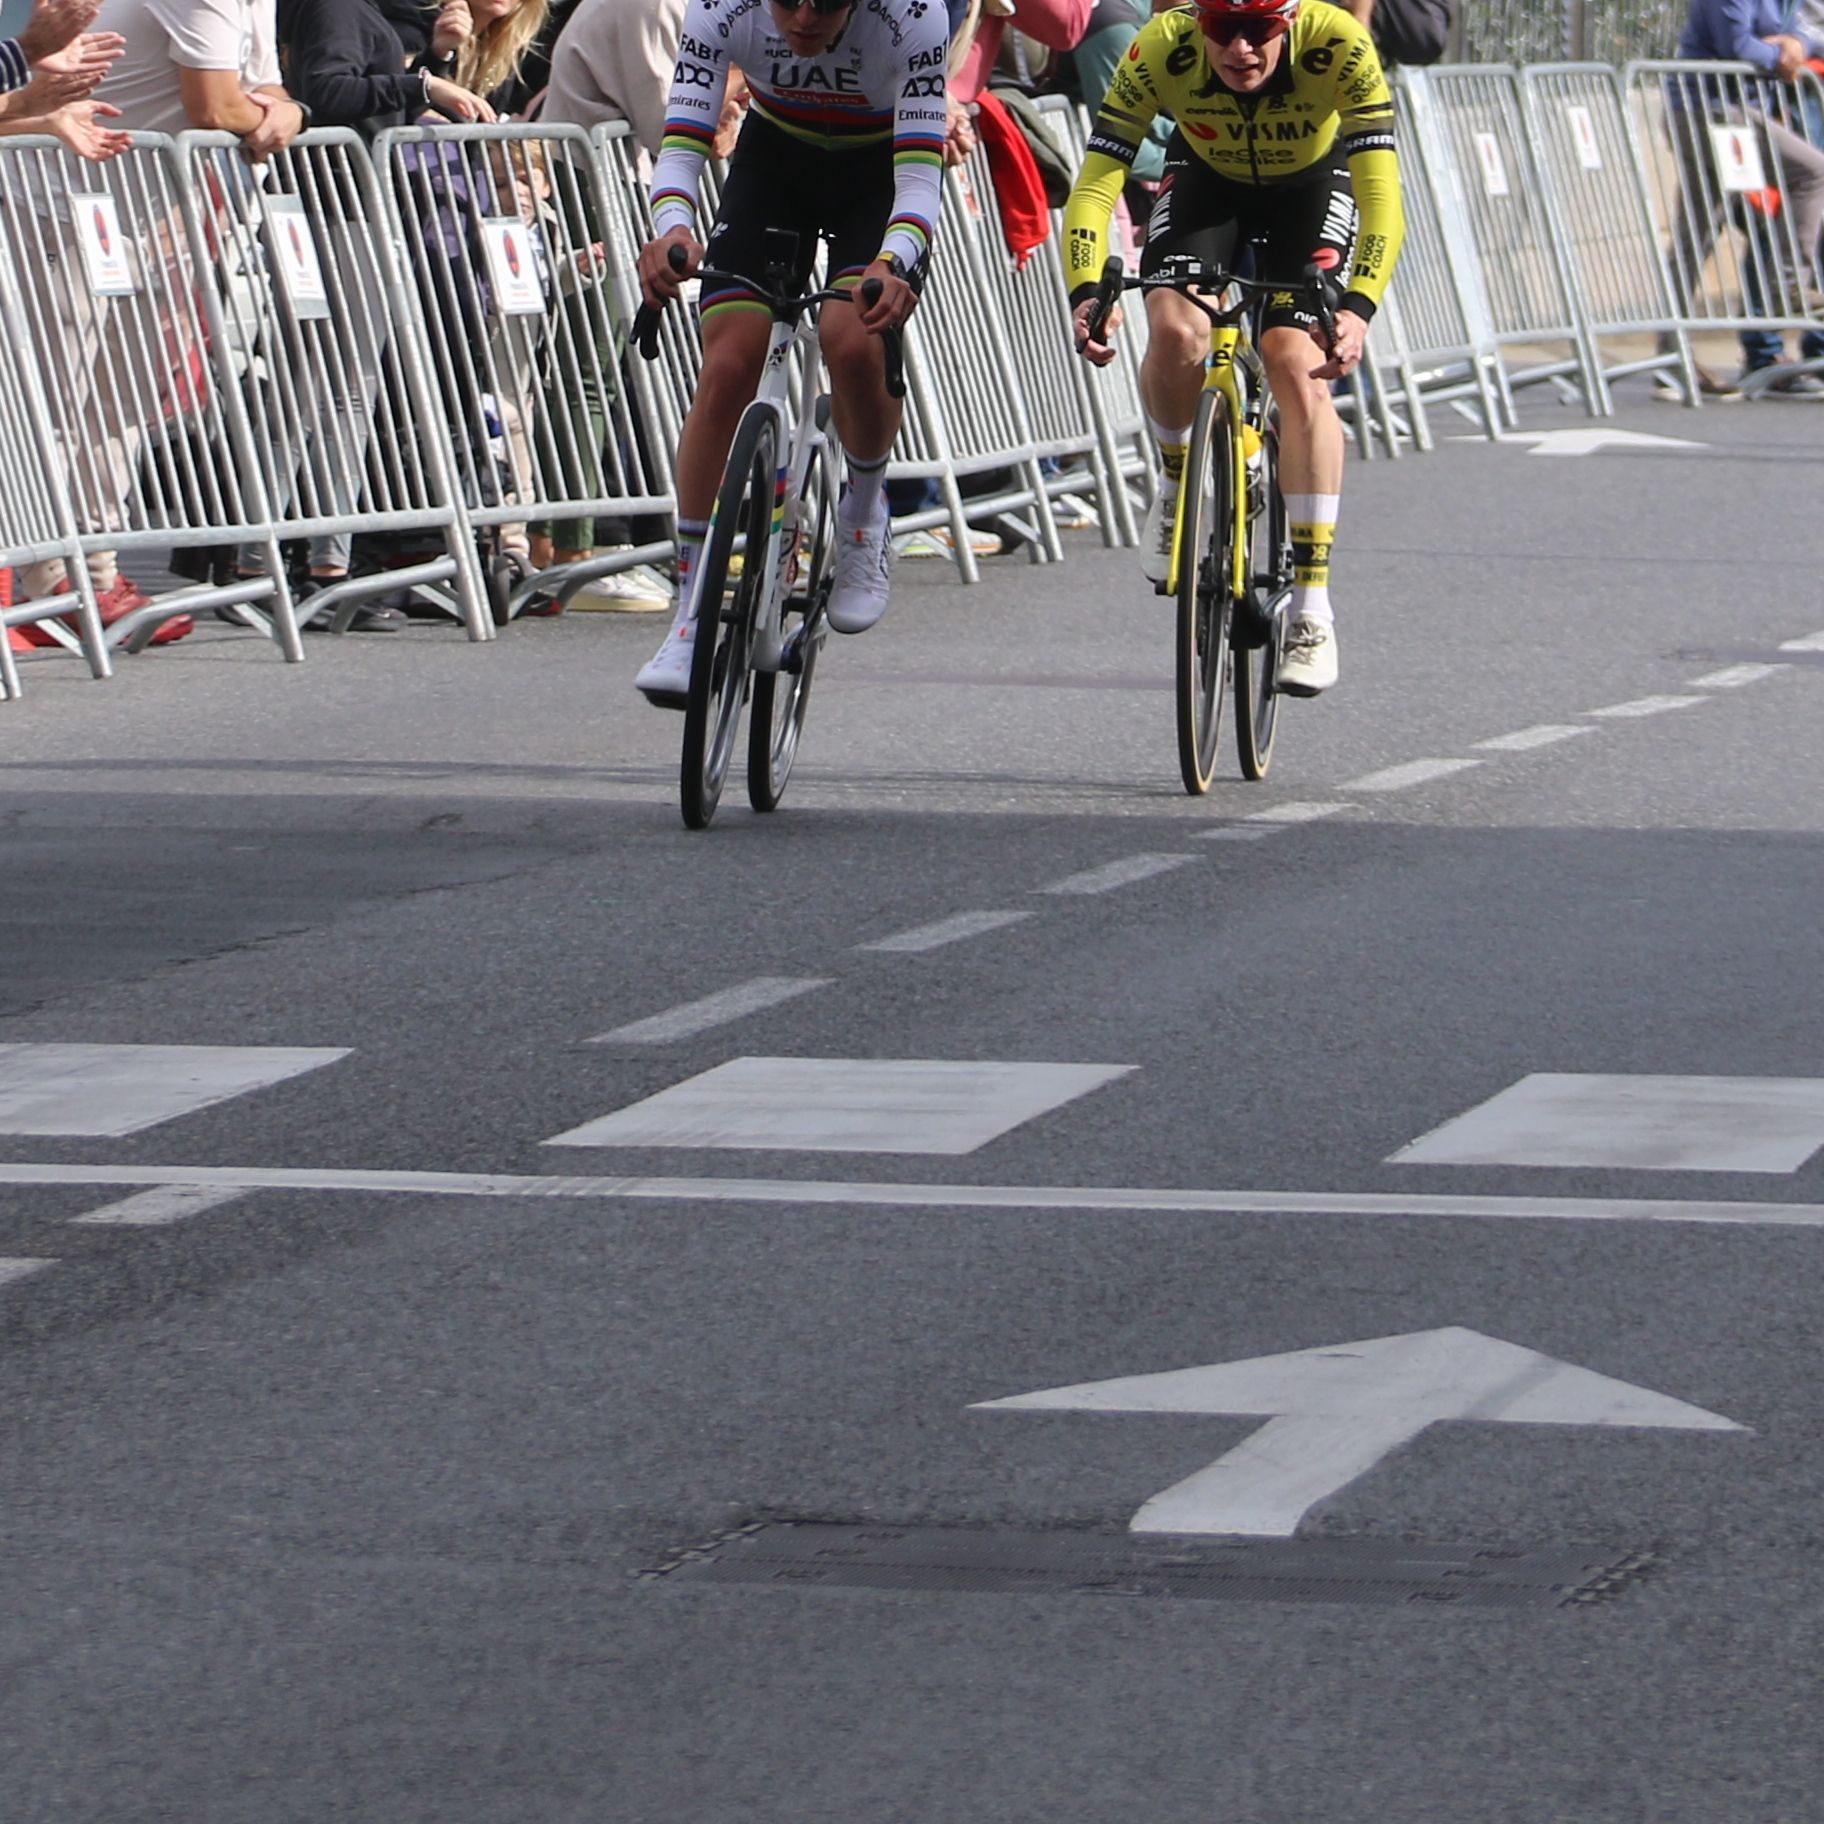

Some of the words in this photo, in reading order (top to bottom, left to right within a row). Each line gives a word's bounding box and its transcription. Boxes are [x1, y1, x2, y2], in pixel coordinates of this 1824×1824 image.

[1337, 38, 1370, 82] VISMA
[770, 62, 863, 94] UAE
[1225, 119, 1319, 142] VISMA
[1087, 136, 1136, 160] SRAM
